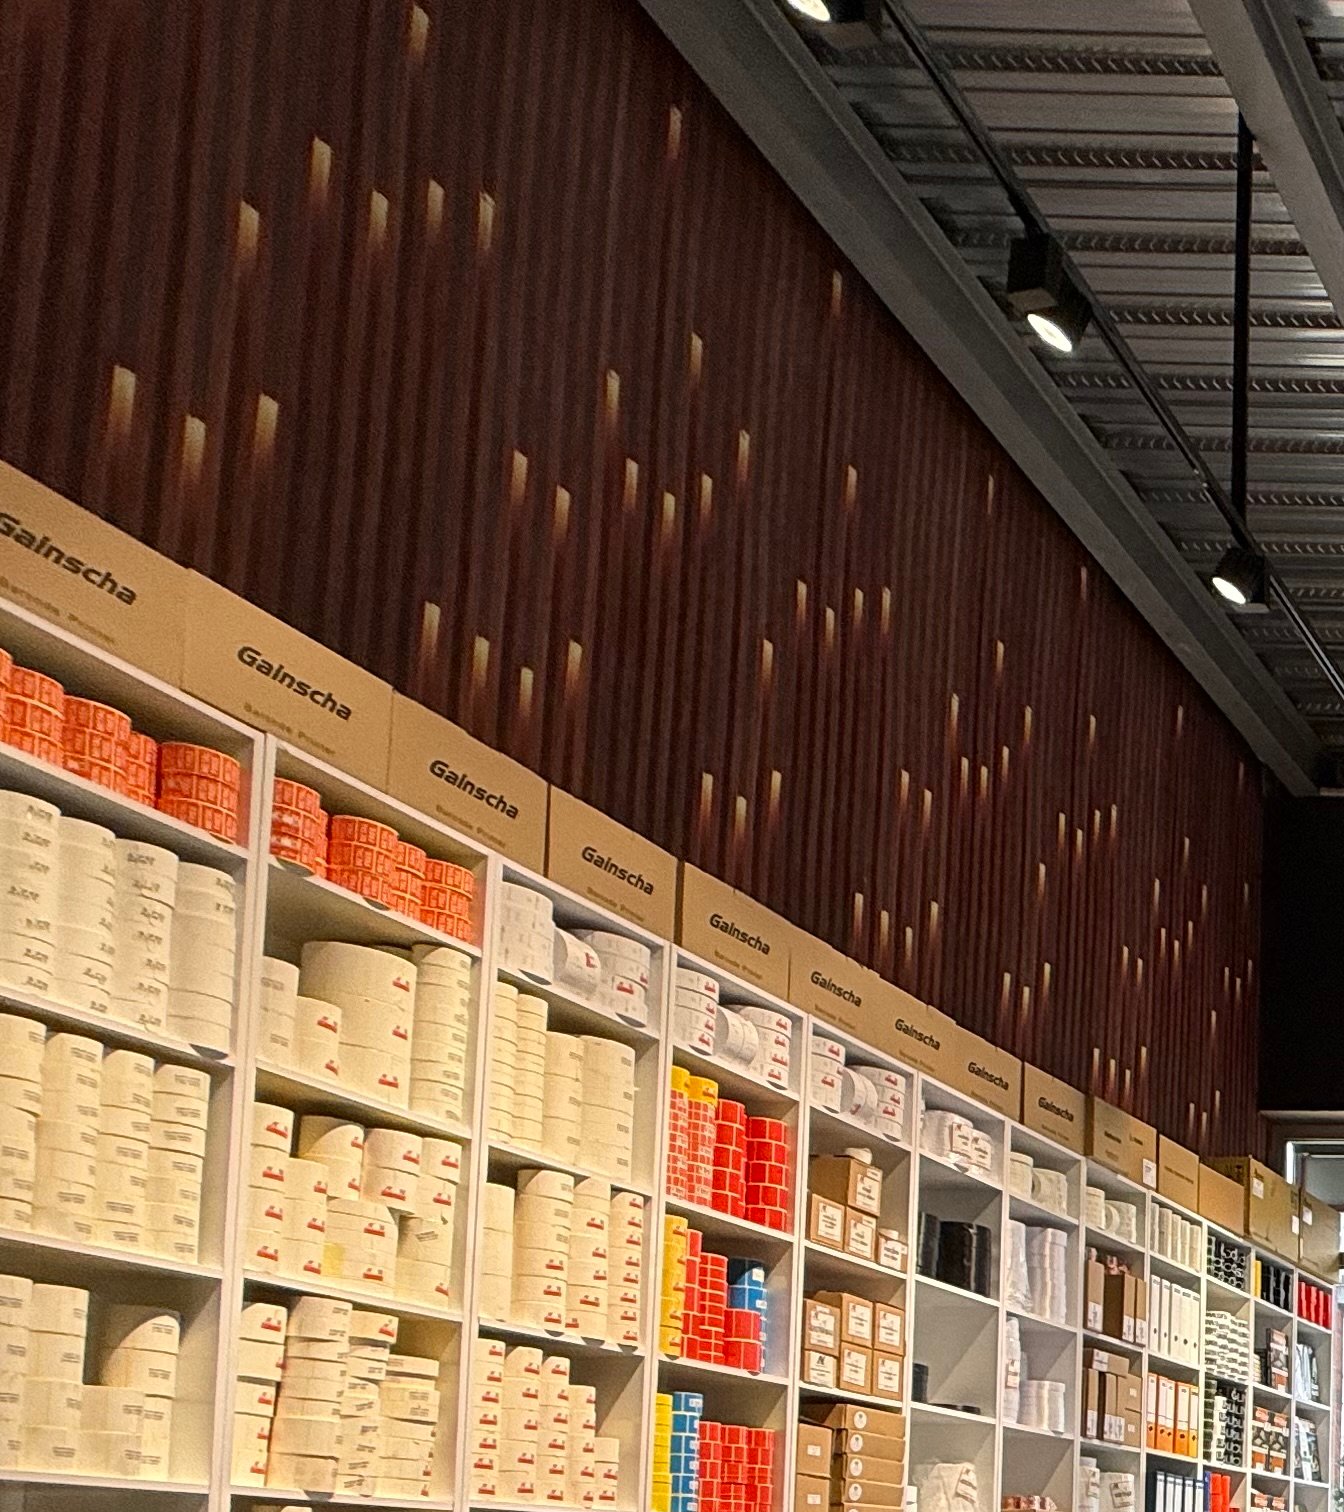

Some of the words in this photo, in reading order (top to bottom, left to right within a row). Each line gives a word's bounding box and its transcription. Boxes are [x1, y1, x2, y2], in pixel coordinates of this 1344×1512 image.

[237, 646, 352, 722] Gainscha
[429, 759, 520, 820] Gainscha
[581, 845, 654, 896] Gainscha
[709, 913, 771, 955] Gainscha
[810, 970, 863, 1008] Gainscha
[895, 1018, 941, 1051] Gainscha
